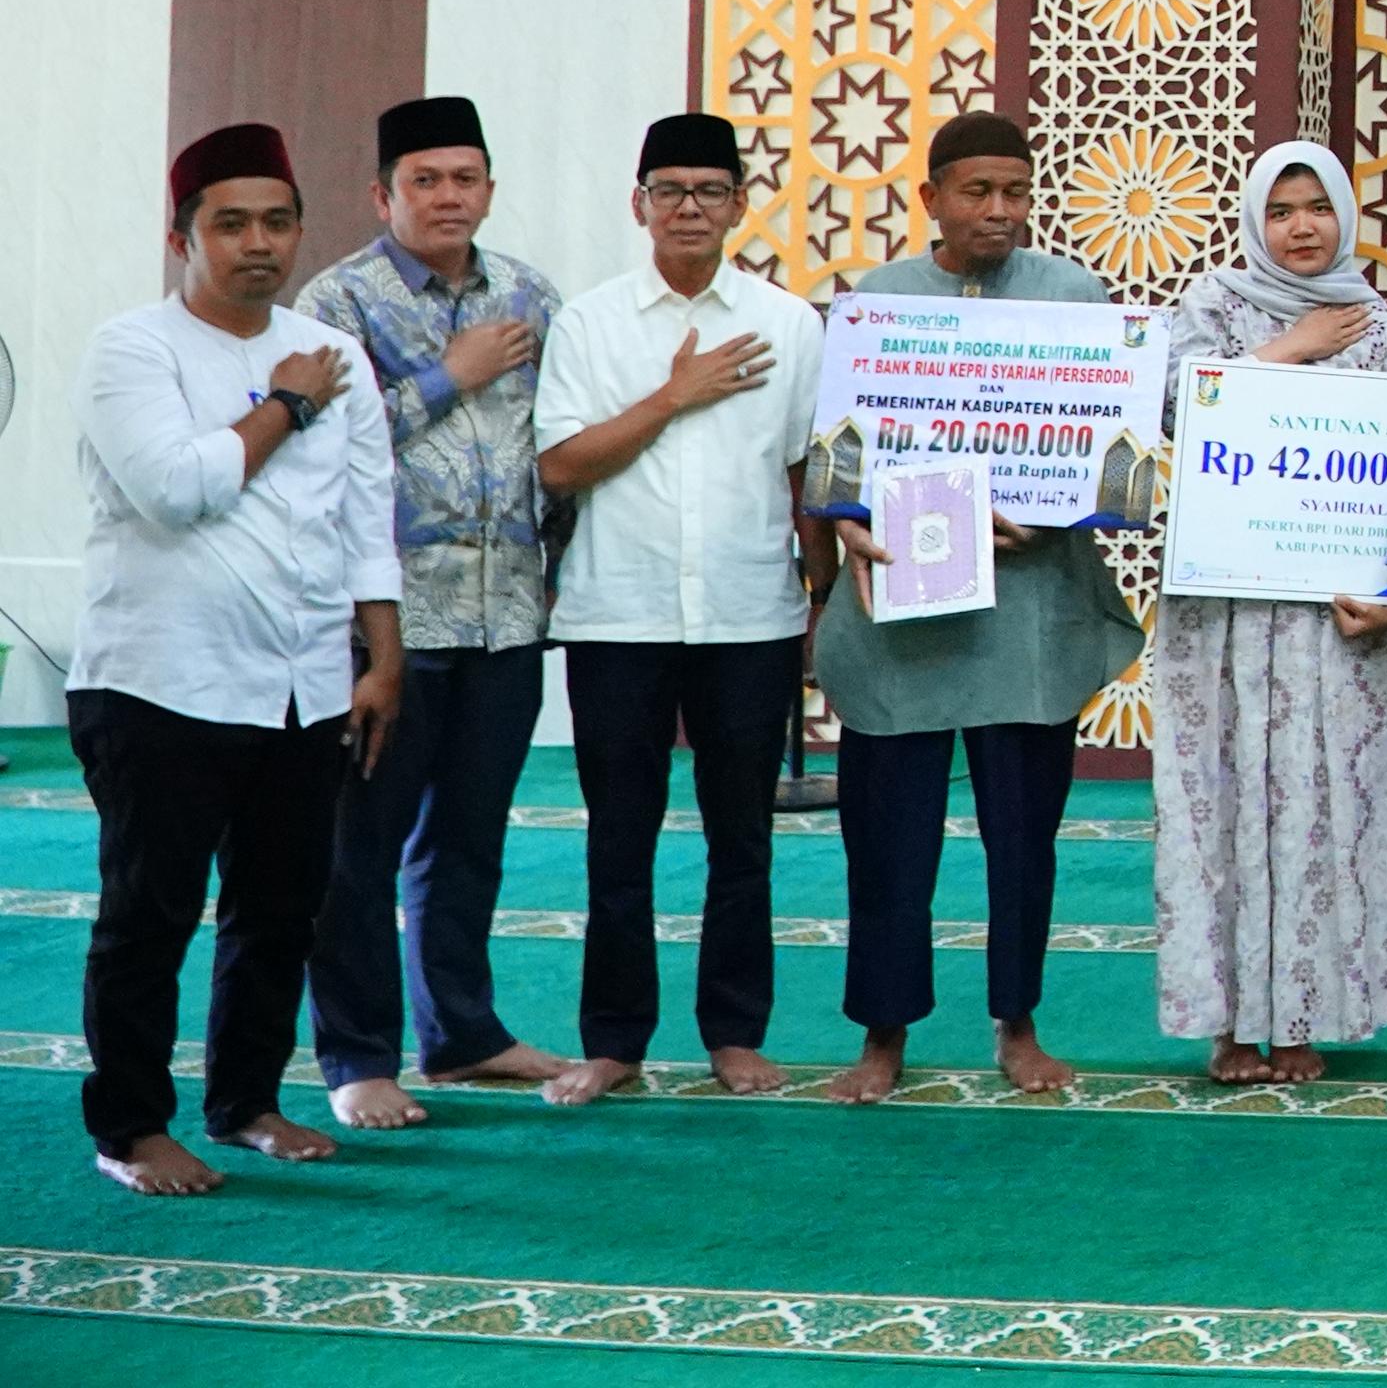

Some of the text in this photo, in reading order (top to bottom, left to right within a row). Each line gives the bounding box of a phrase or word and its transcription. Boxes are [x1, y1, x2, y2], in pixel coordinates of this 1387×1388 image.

[868, 310, 960, 329] brksyariah
[880, 338, 1112, 362] BANTUAN PROGRAM KEMITRAAN
[852, 358, 1135, 385] PT. BANK RIAU KEPRI SYARIAH (PERSERODA)
[978, 384, 1005, 393] DAN
[856, 394, 1123, 419] PEMERINTAH KABUPATEN KAMPAR
[1268, 413, 1381, 436] SANTUNAN
[876, 416, 1094, 459] Rp. 20.000.000
[989, 464, 1012, 477] uta
[1018, 464, 1078, 481] Rupiah
[1199, 439, 1255, 487] Rp
[1248, 519, 1304, 534] PESERTA
[1306, 522, 1330, 535] BPU
[1333, 524, 1366, 538] DARI
[1275, 540, 1350, 555] KABUPATEN
